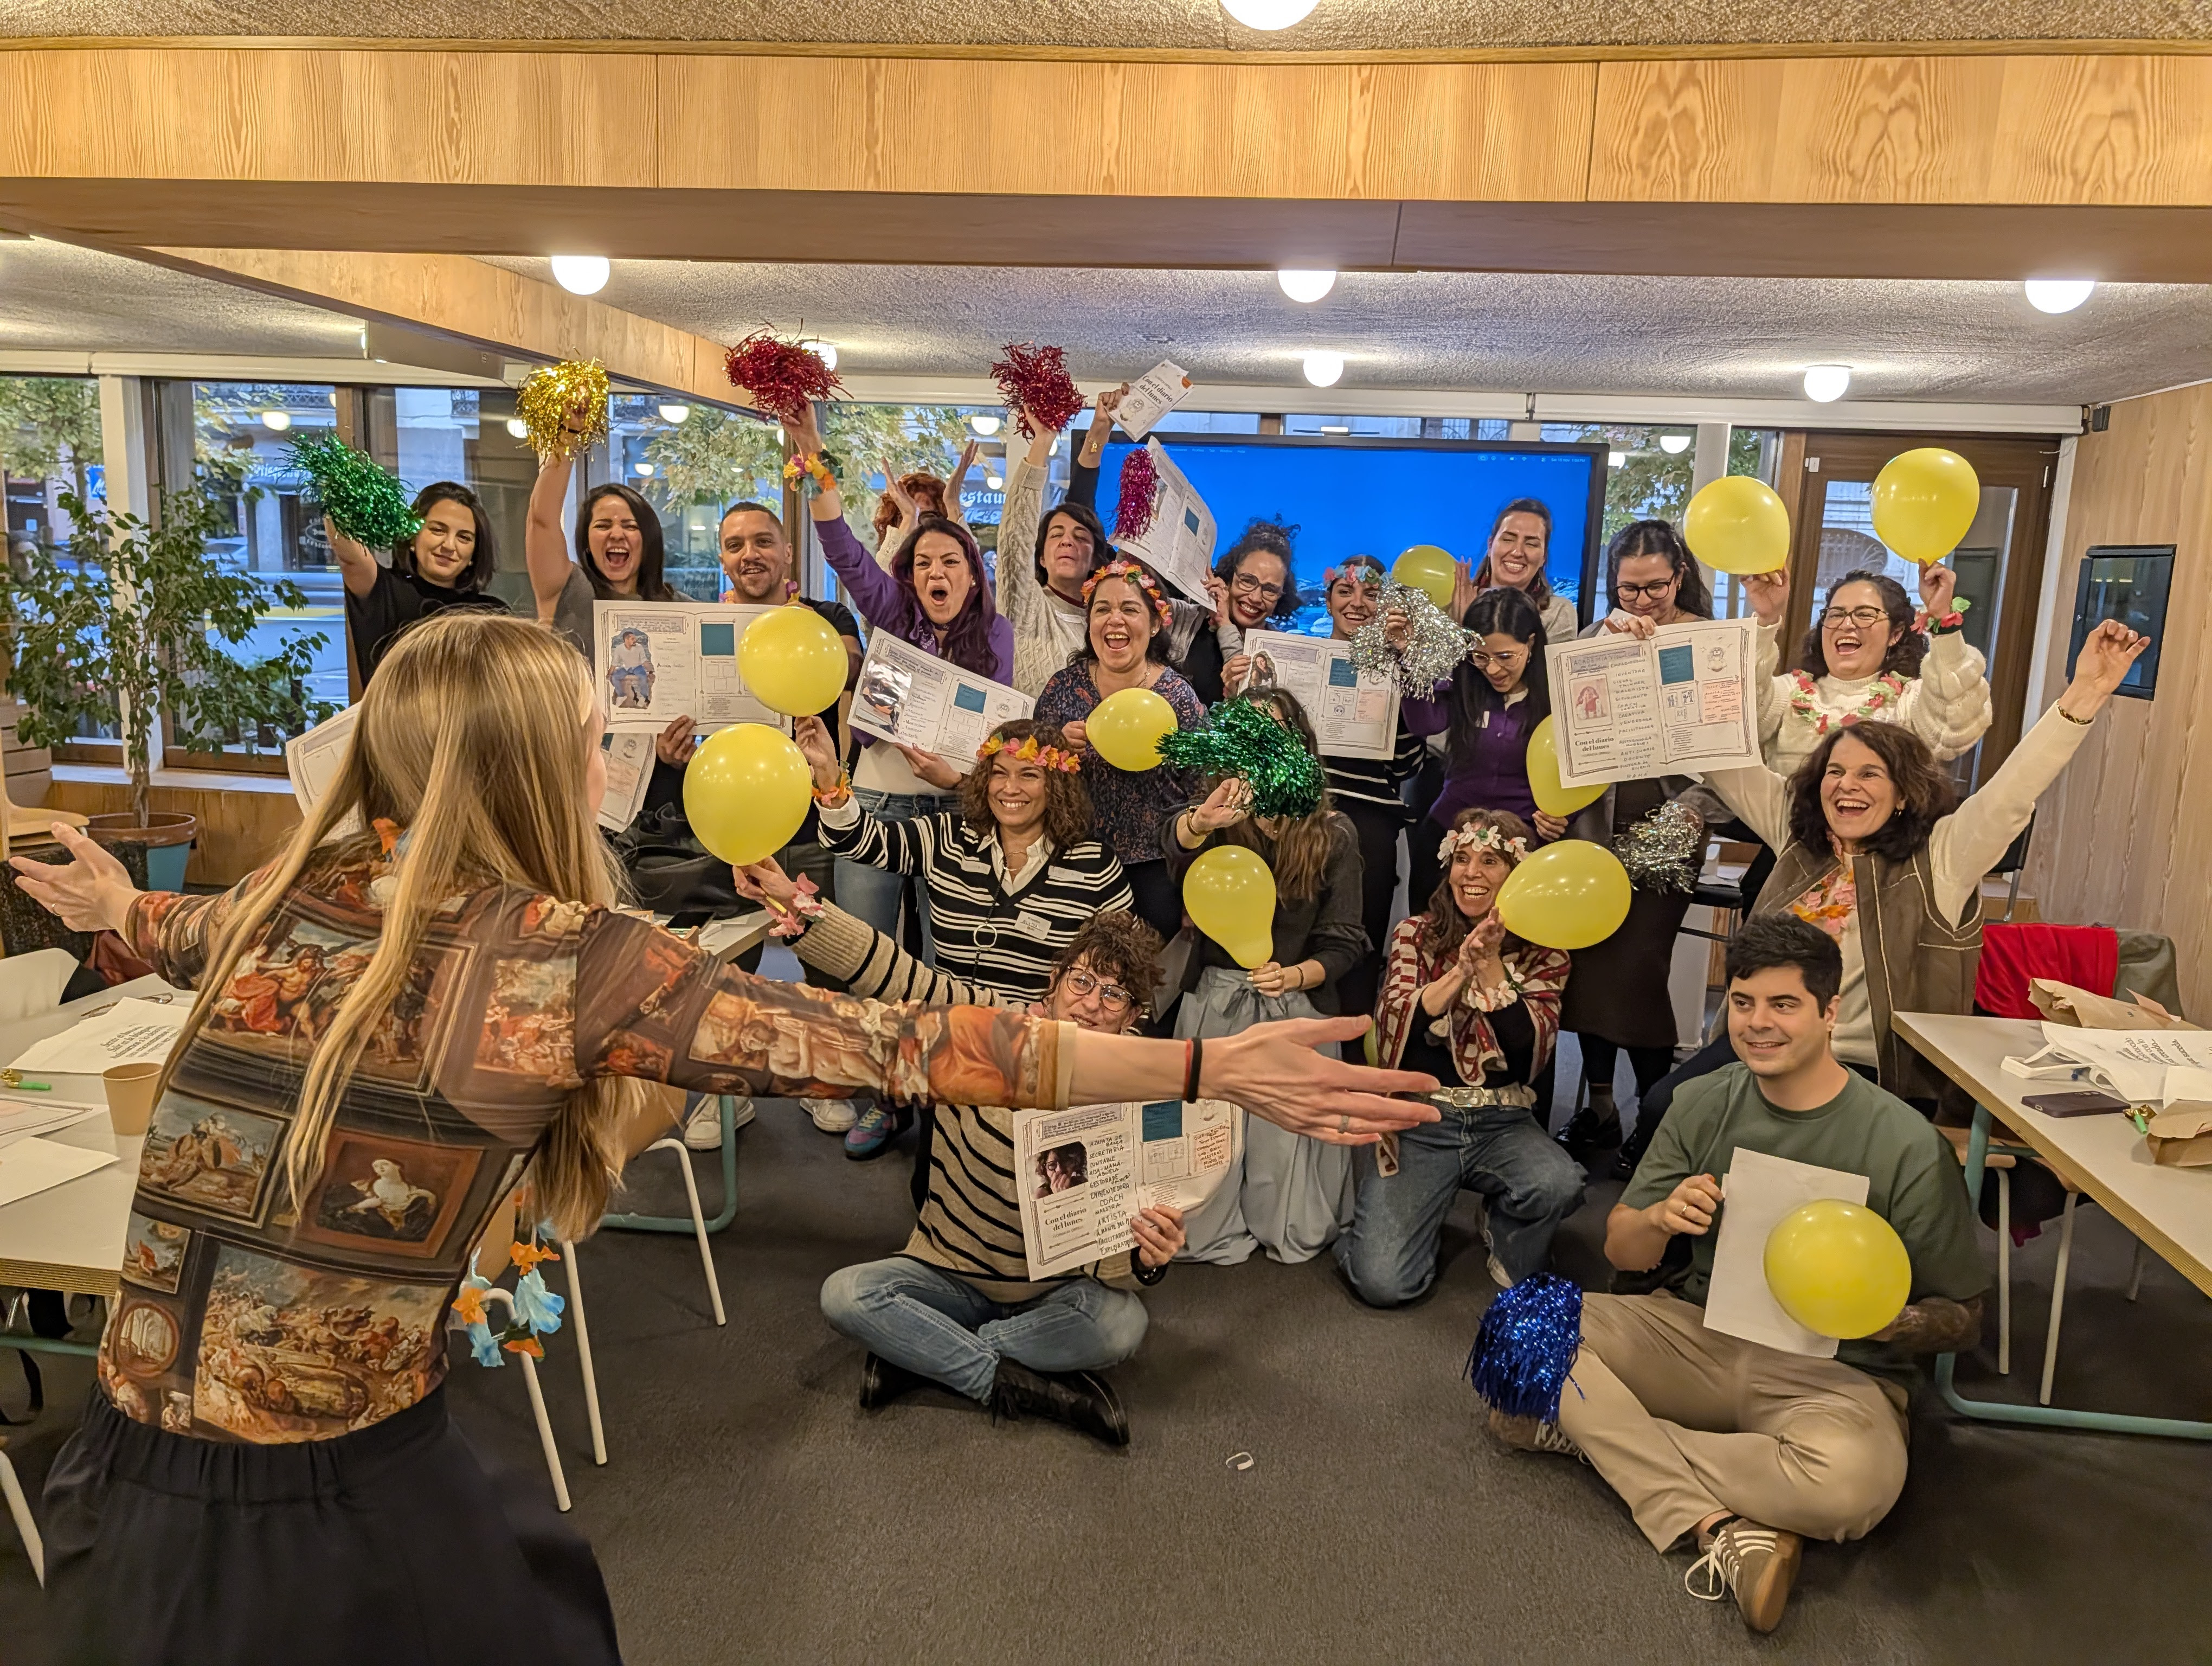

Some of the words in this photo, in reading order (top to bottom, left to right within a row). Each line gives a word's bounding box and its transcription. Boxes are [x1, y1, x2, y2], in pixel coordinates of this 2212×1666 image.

[1142, 375, 1153, 385] Con
[1156, 387, 1173, 402] diario
[1147, 390, 1162, 405] lunes
[1090, 1156, 1116, 1168] CONTABLE
[1097, 1168, 1119, 1178] ABUELA
[1099, 1193, 1123, 1207] COACH
[1066, 1207, 1086, 1218] diario
[1095, 1203, 1121, 1215] MAESTRA
[1097, 1210, 1127, 1227] ARTISTA
[1053, 1222, 1064, 1231] del
[1064, 1219, 1083, 1227] lunes
